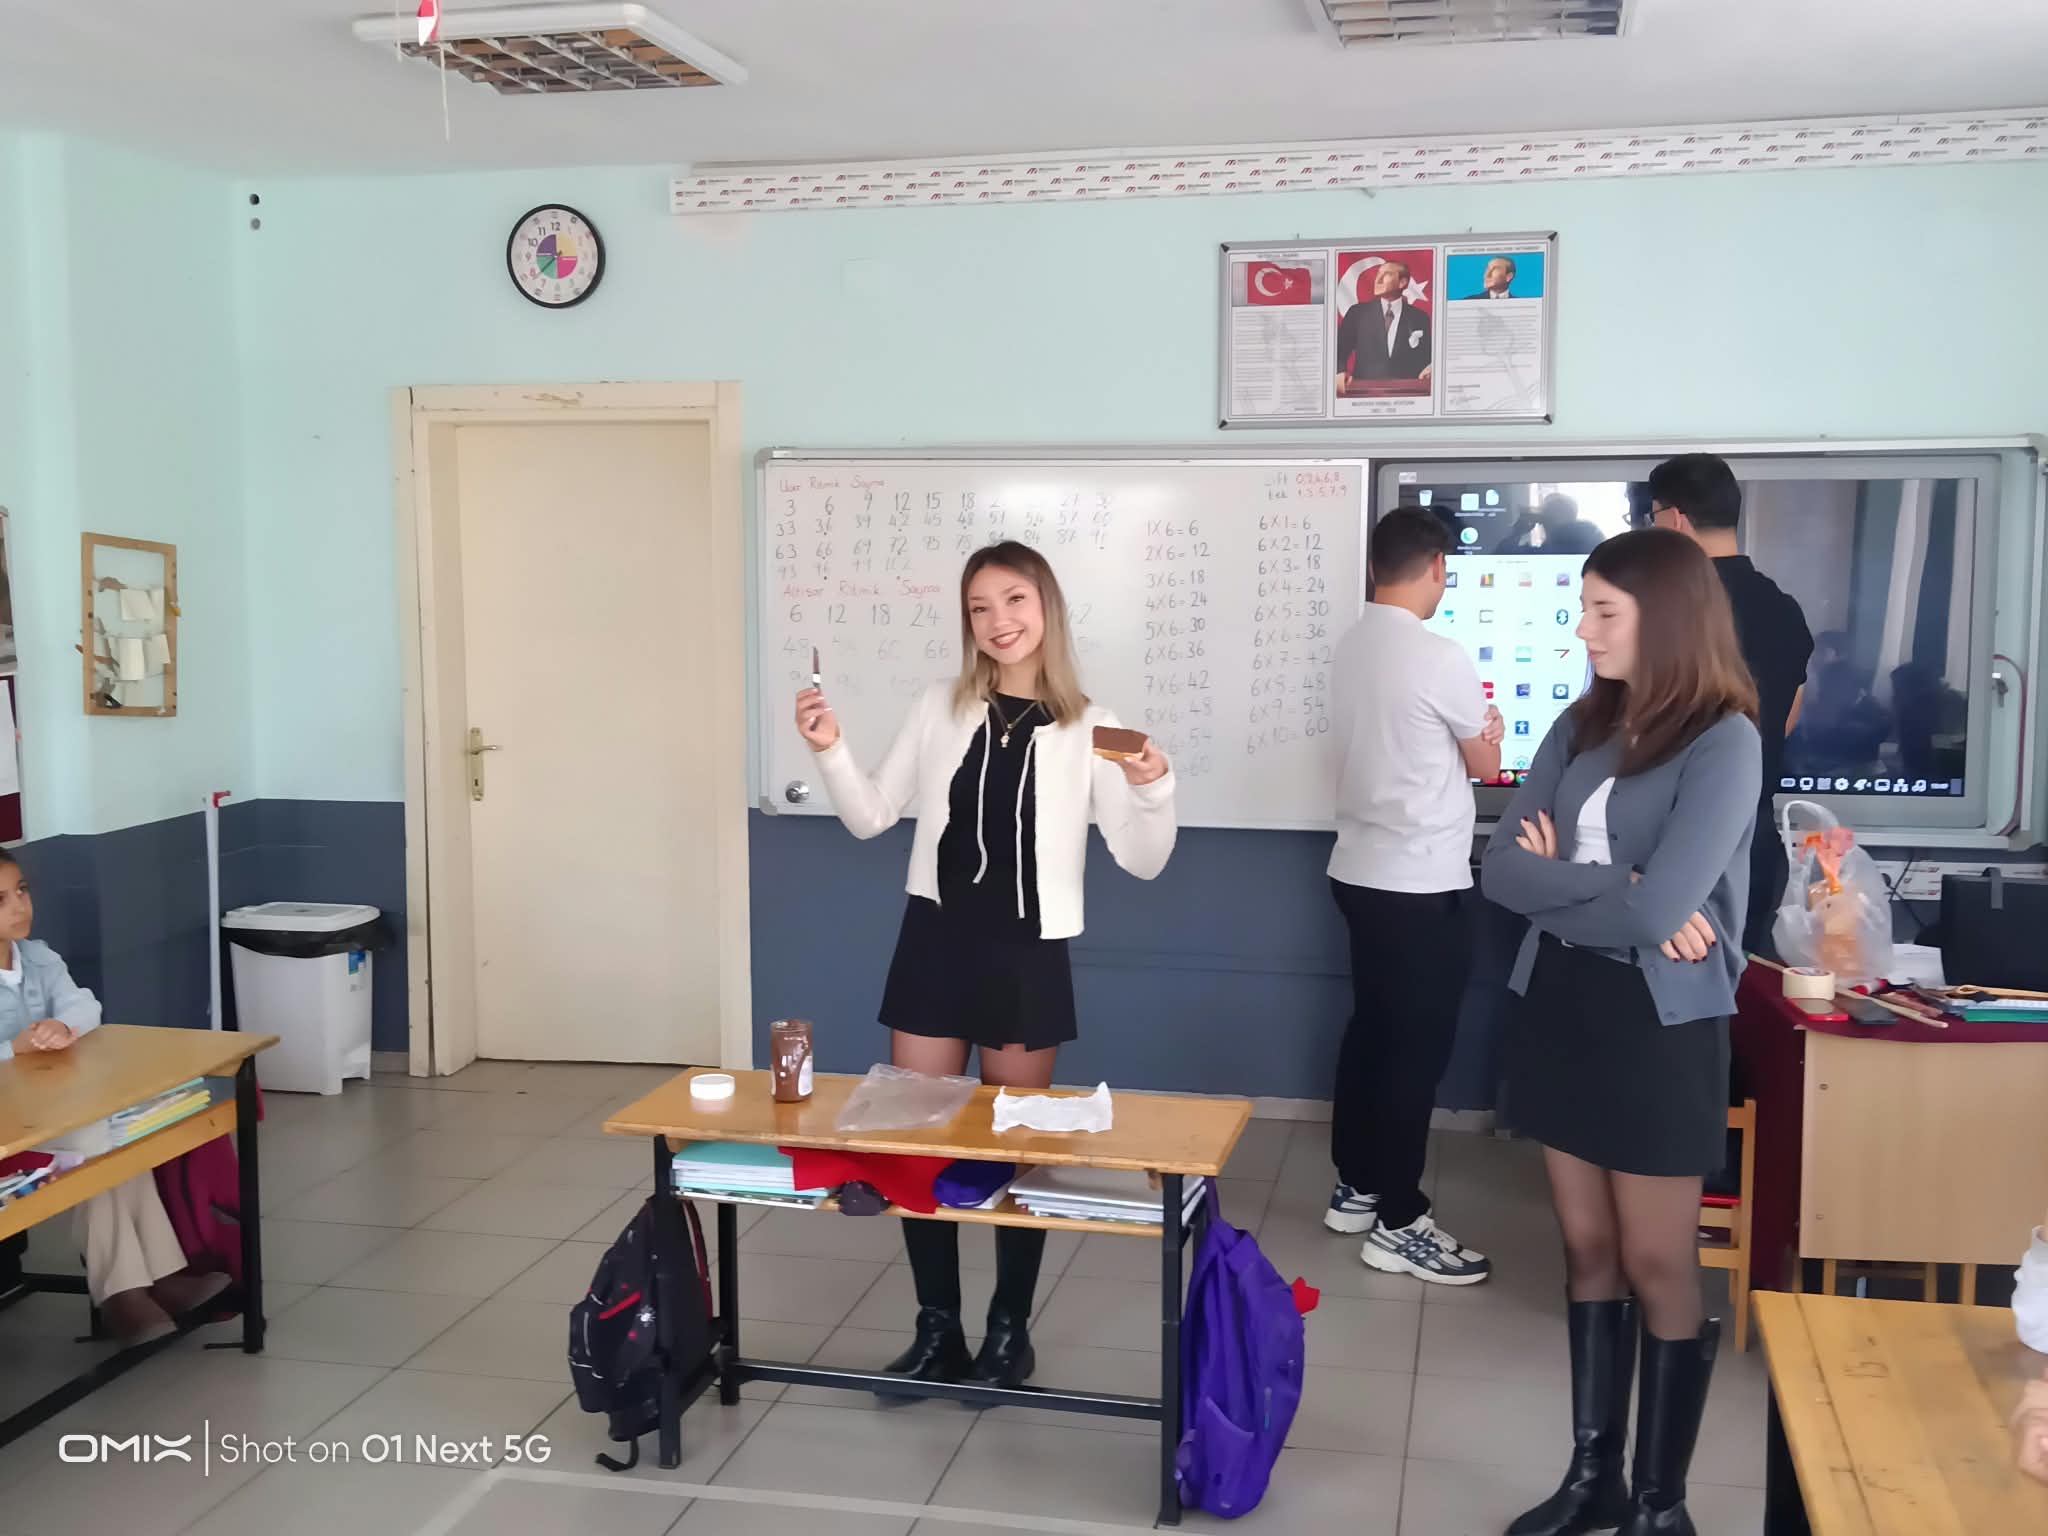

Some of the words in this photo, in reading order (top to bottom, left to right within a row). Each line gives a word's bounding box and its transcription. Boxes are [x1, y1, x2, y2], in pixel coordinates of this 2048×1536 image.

[538, 227, 546, 236] 11
[550, 222, 561, 231] 12
[784, 499, 796, 517] 3
[825, 496, 834, 512] 6
[896, 491, 913, 511] 12
[926, 491, 943, 510] 15
[961, 491, 976, 509] 18
[776, 520, 797, 537] 33
[776, 543, 798, 560] 63
[888, 536, 909, 554] 72
[790, 604, 802, 623] 6
[828, 603, 847, 625] 12
[872, 603, 890, 626] 18
[910, 602, 942, 628] 24
